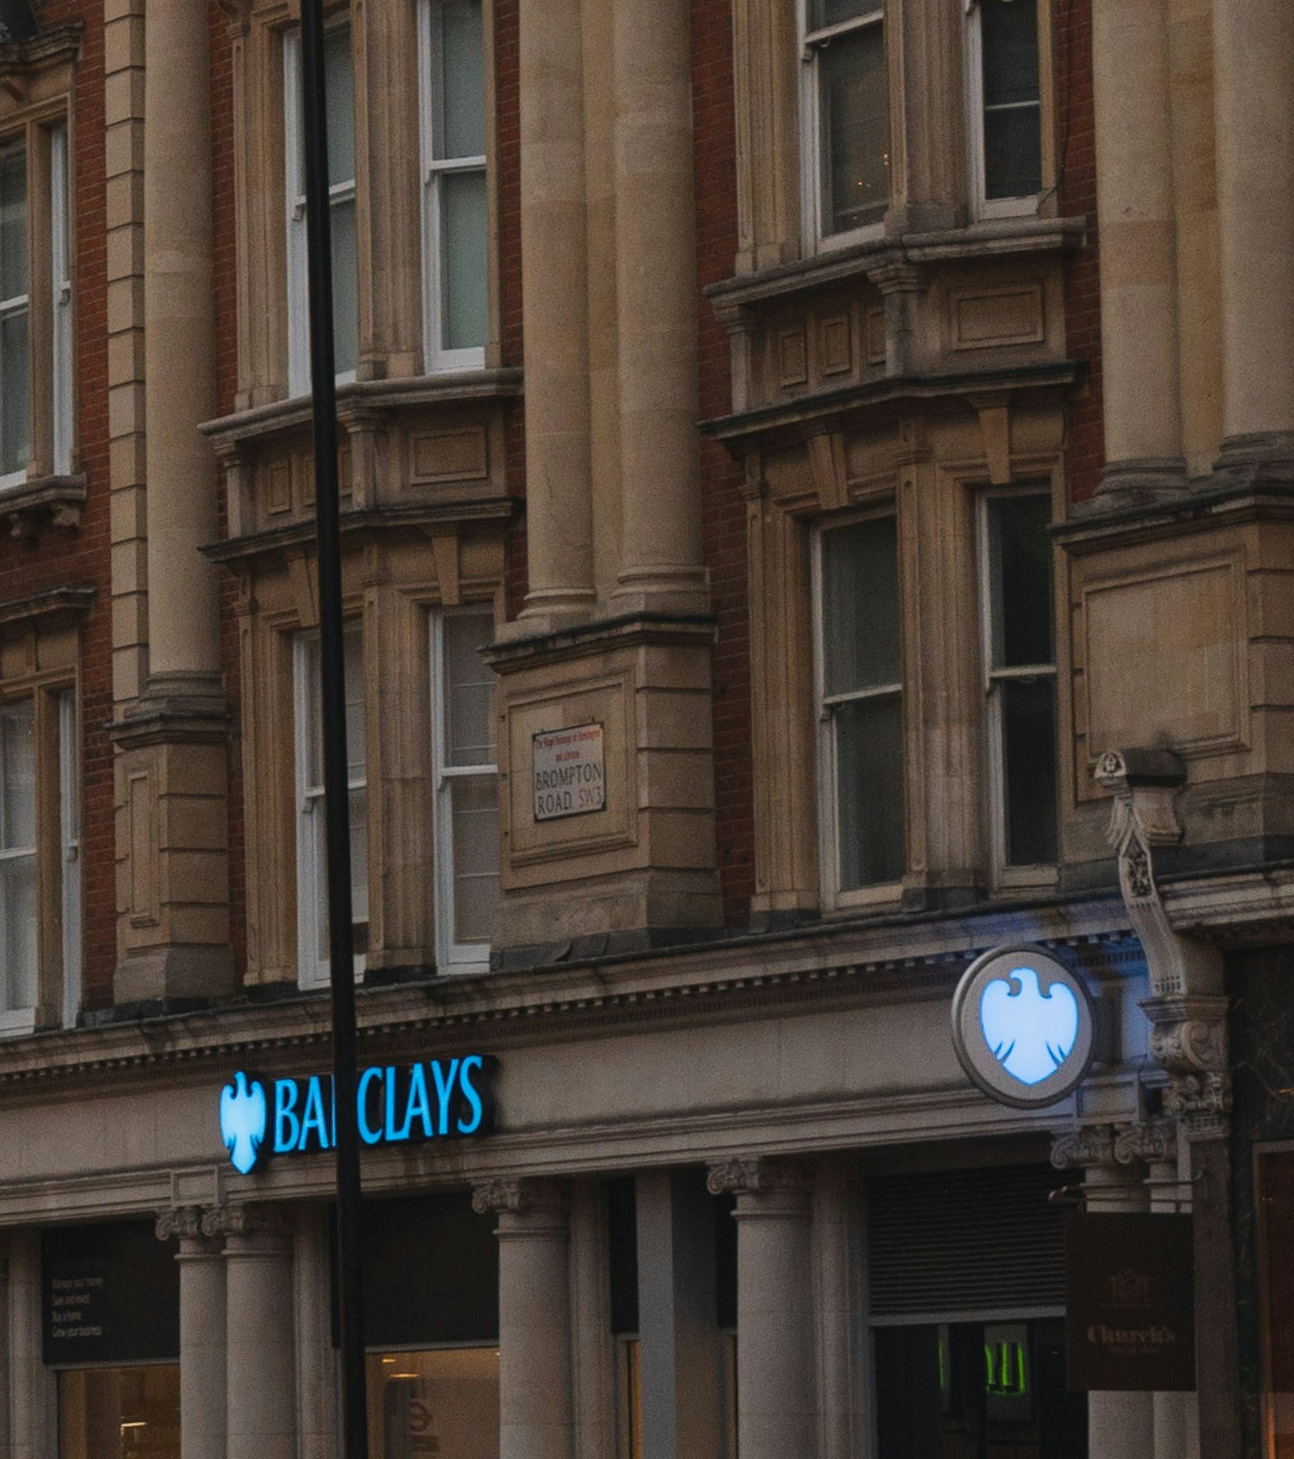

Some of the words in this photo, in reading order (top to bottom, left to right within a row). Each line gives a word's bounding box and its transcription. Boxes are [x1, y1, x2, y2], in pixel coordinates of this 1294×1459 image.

[536, 763, 601, 791] BROMPTON
[537, 791, 572, 814] ROAD
[579, 786, 601, 808] SW3
[274, 1054, 483, 1153] BACLAYS
[1087, 1324, 1176, 1344] Church's
